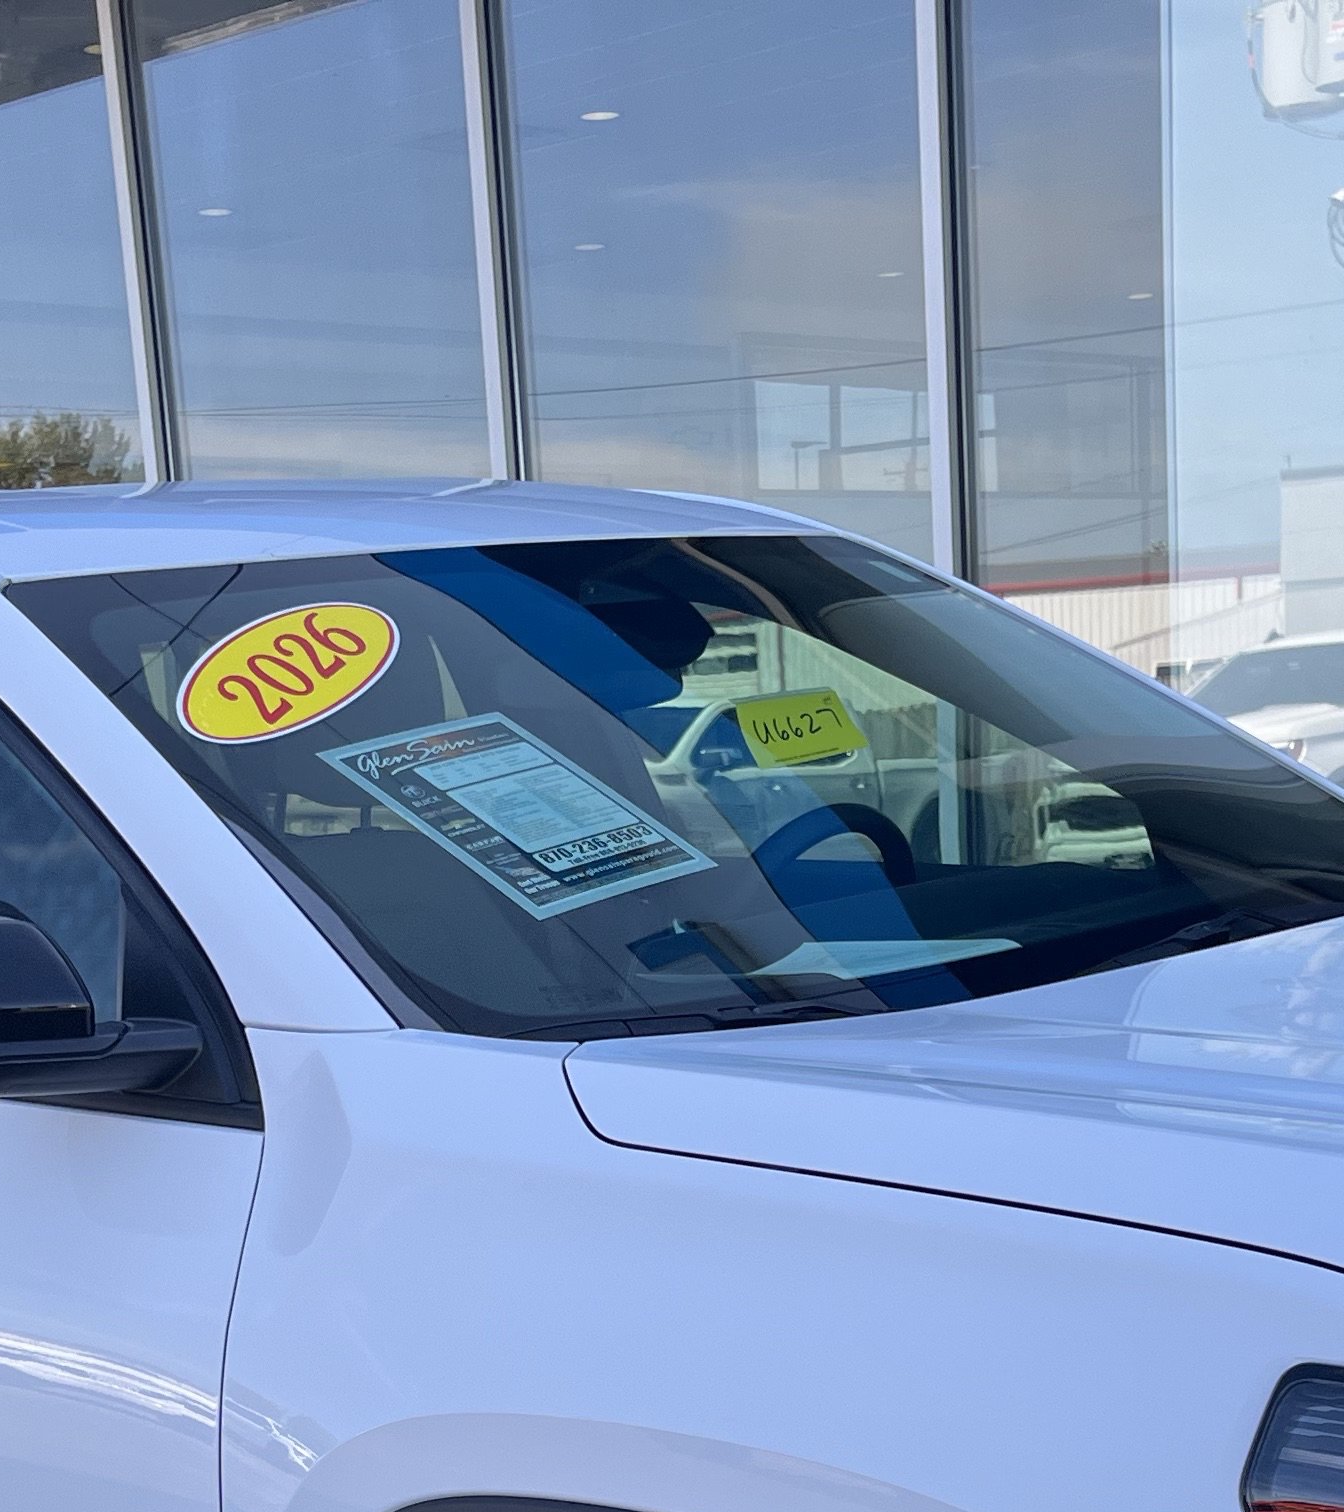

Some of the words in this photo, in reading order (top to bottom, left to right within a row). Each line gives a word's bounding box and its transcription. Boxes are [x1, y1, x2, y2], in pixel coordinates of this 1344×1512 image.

[218, 612, 367, 725] 2026
[356, 751, 414, 780] Glen
[406, 738, 475, 760] Sain
[538, 824, 653, 865] 870-236-8503
